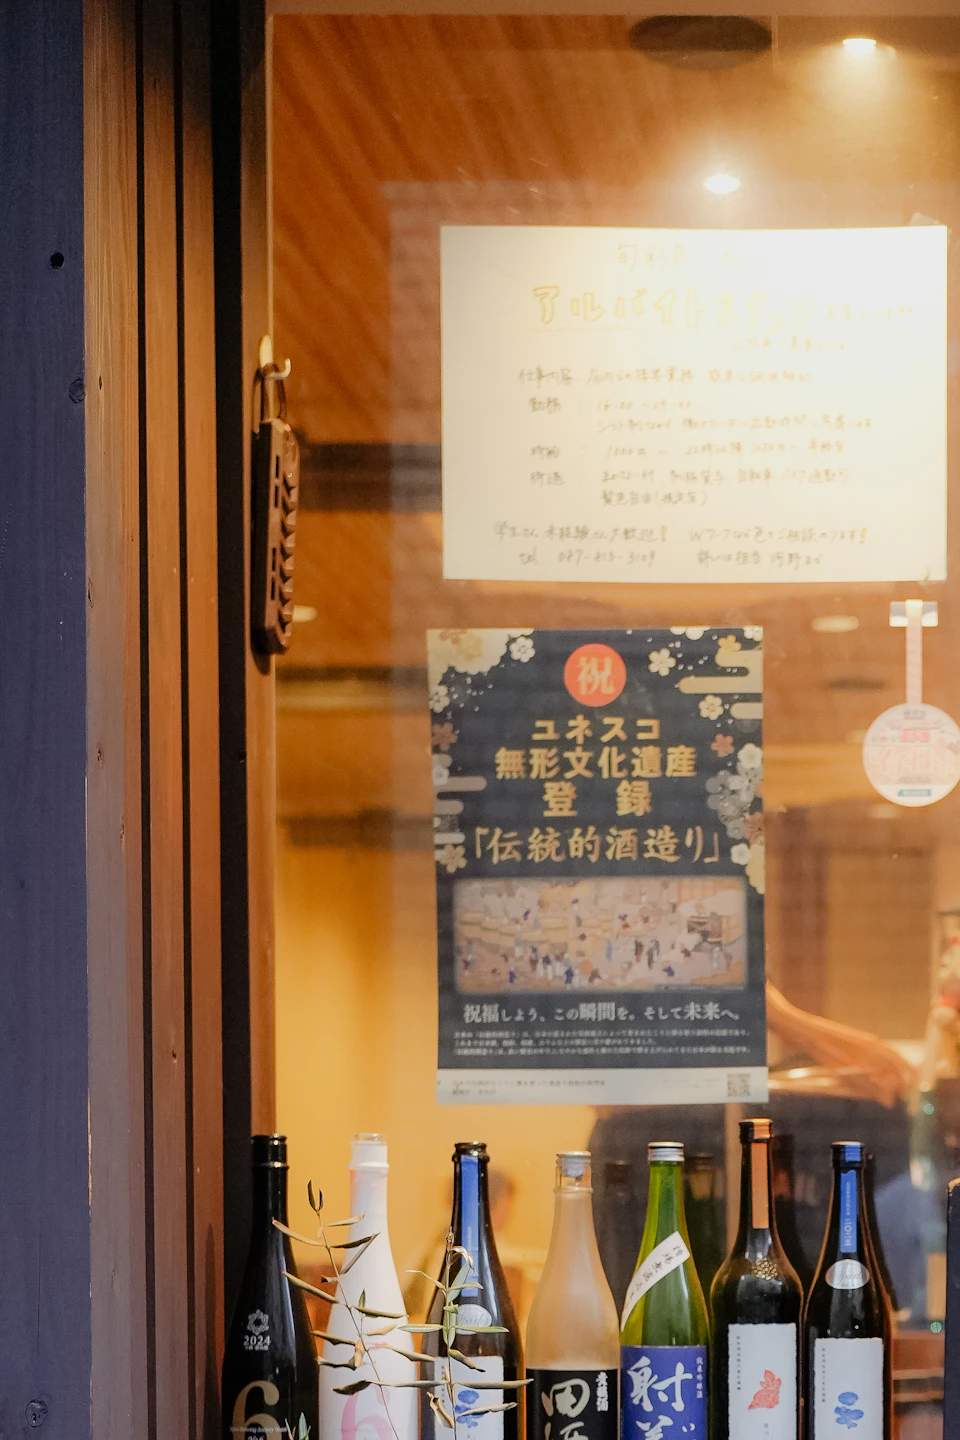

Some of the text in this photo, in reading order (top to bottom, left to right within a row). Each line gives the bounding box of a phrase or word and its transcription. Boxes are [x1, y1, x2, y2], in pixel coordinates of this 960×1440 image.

[577, 656, 616, 695] 祝
[532, 715, 661, 743] ユネスコ
[495, 746, 697, 779] 無形文化遺産
[542, 780, 653, 817] 登録
[474, 826, 720, 863] 「伝統的酒造り」
[243, 1335, 271, 1346] 2024
